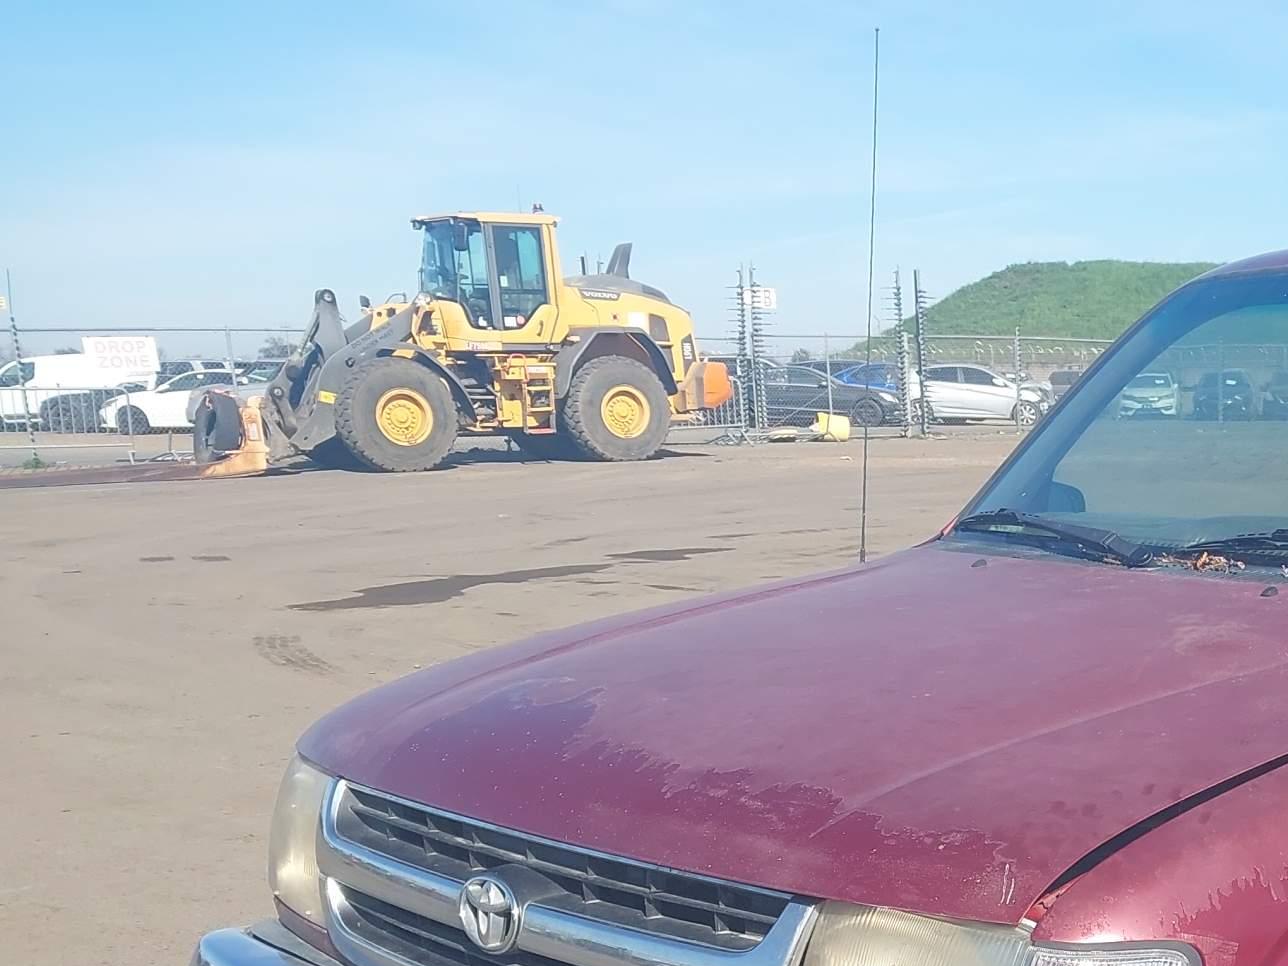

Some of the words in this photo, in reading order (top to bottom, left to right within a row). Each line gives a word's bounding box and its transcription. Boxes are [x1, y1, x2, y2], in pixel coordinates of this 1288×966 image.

[582, 291, 618, 299] VOLVO
[94, 340, 146, 354] DROP
[96, 355, 152, 369] ZONE
